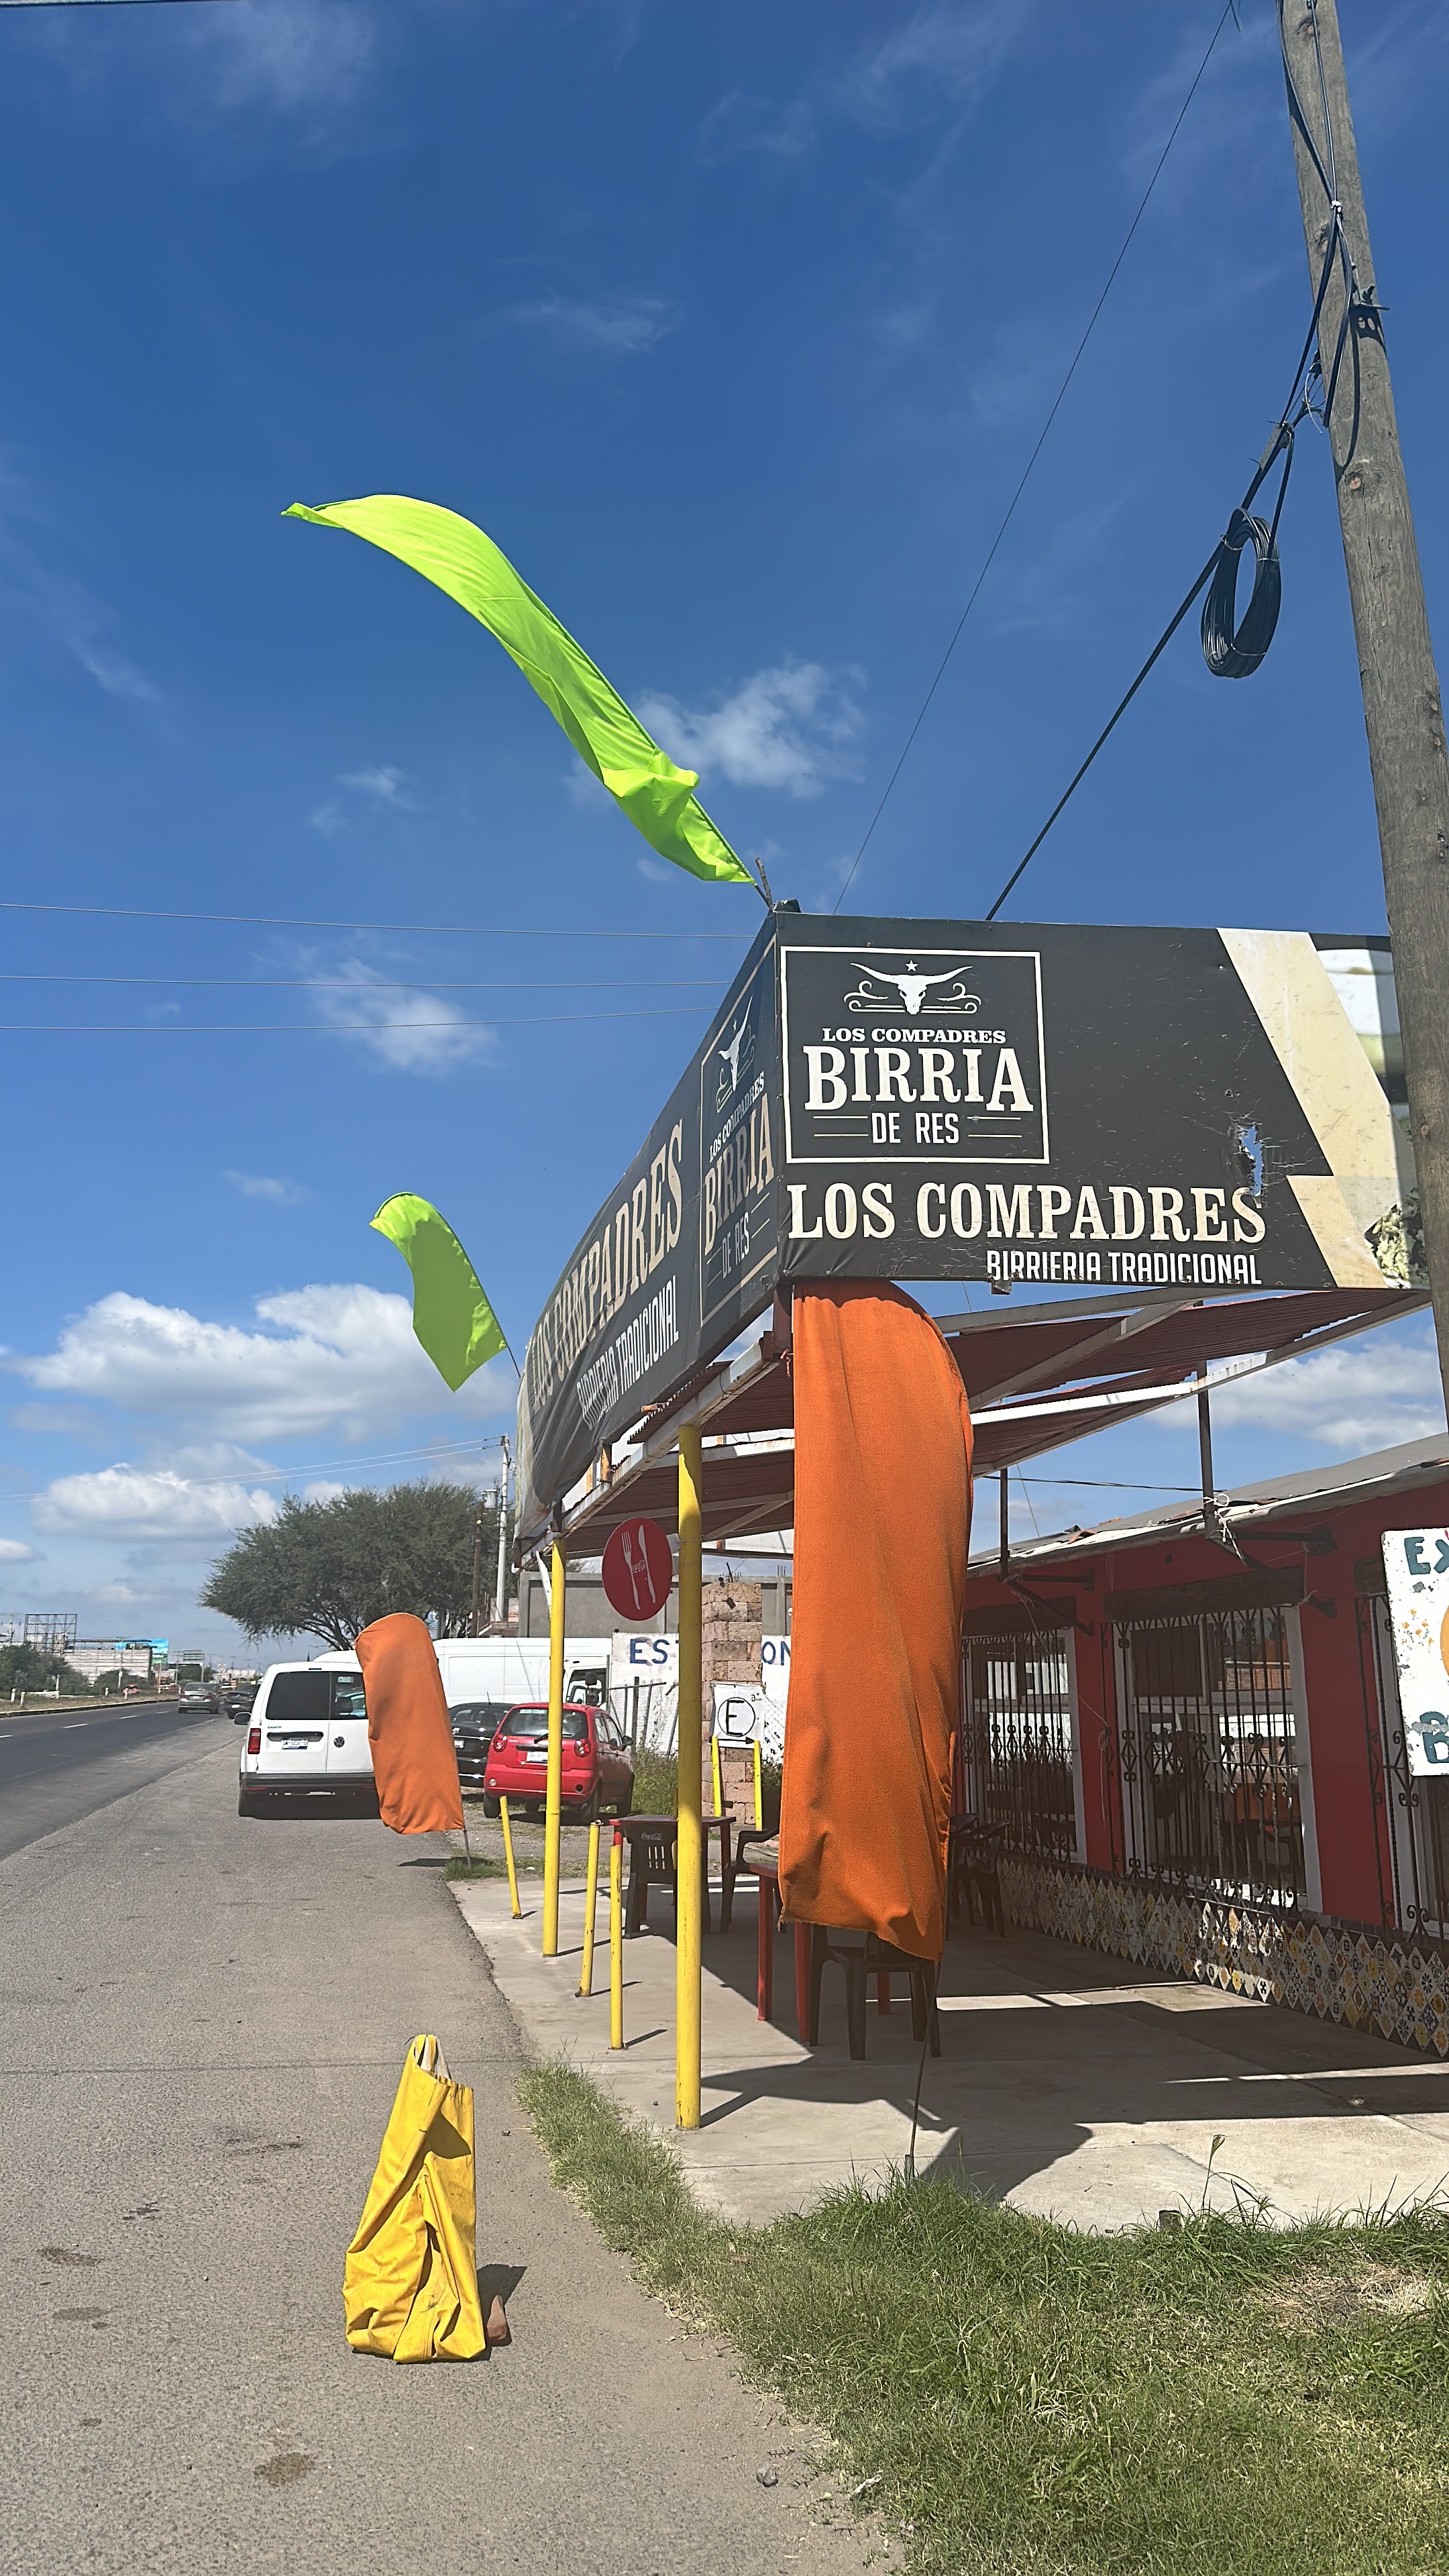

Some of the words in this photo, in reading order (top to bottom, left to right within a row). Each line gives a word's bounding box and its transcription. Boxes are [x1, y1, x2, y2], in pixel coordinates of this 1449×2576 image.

[822, 1028, 865, 1042] LOS
[870, 1028, 1006, 1044] COMPADRES
[802, 1045, 1034, 1112] BIRRIA
[709, 1137, 722, 1163] LOS
[722, 1071, 765, 1142] COMPADRES
[871, 1112, 901, 1144] DE
[915, 1112, 959, 1144] RES
[704, 1092, 774, 1256] BIRRIA
[722, 1231, 733, 1279] DE
[735, 1211, 750, 1265] RES
[787, 1182, 895, 1240] LOS
[916, 1182, 1267, 1243] COMPADRES
[553, 1118, 683, 1383] COMPADRES
[987, 1250, 1101, 1282] BIRRIERIA
[1108, 1251, 1262, 1285] TRADICIONAL
[616, 1275, 679, 1395] TRADICIONAL
[725, 1699, 745, 1735] E
